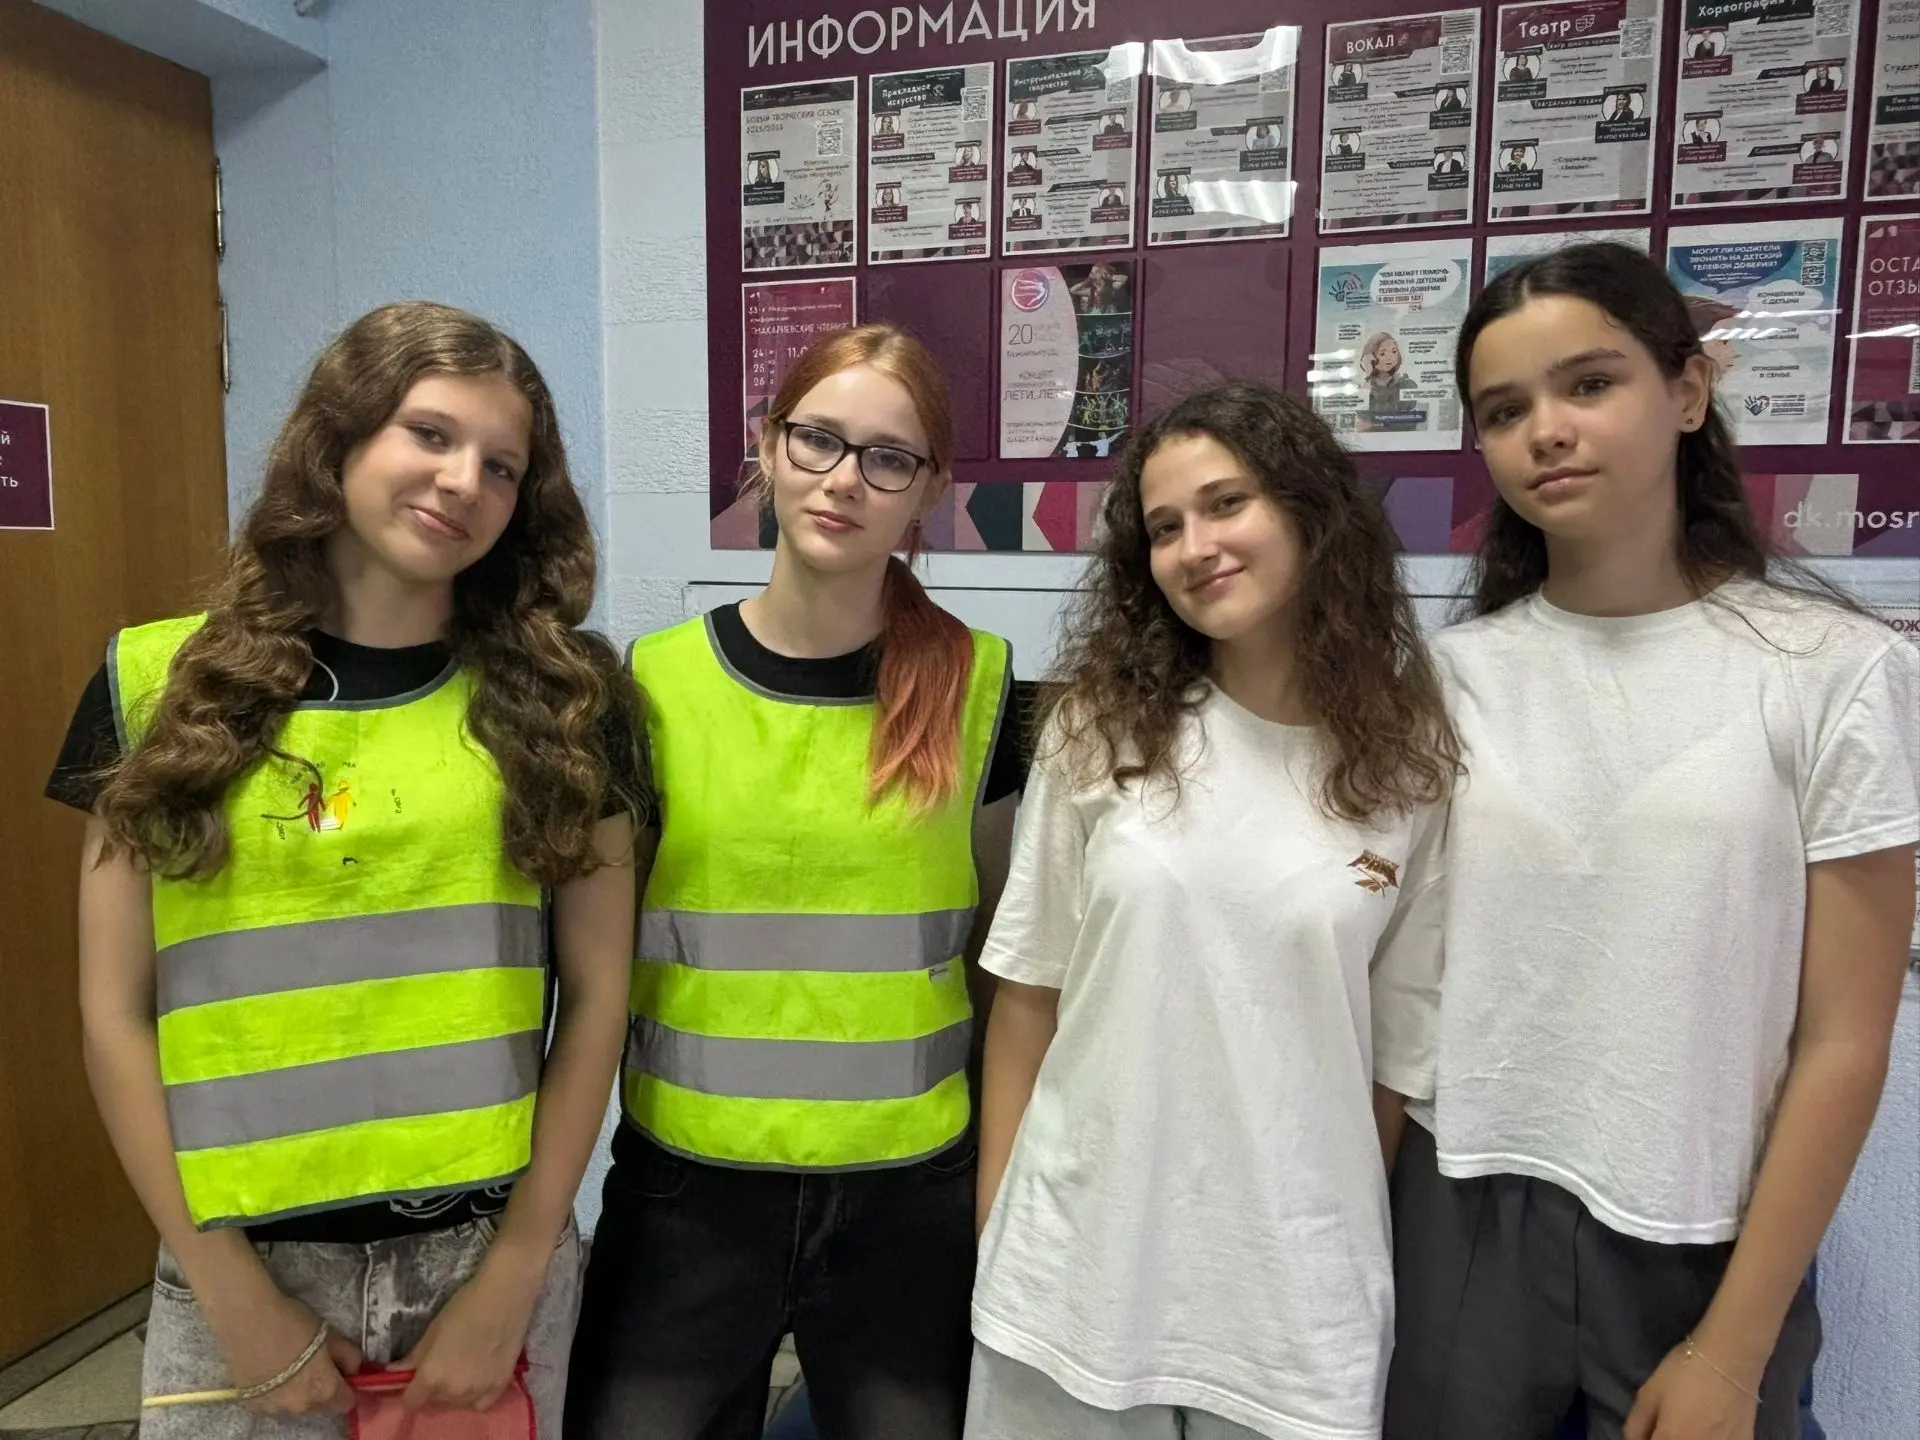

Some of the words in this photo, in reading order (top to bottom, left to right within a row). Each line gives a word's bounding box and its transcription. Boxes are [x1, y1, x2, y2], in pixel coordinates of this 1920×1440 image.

[748, 0, 1096, 68] ИНФОРМАЦИЯ
[1519, 19, 1572, 39] Театр
[1346, 34, 1395, 54] ВОКАЛ
[882, 83, 931, 99] Прикладное
[887, 94, 928, 108] искусство
[1008, 323, 1033, 346] 20
